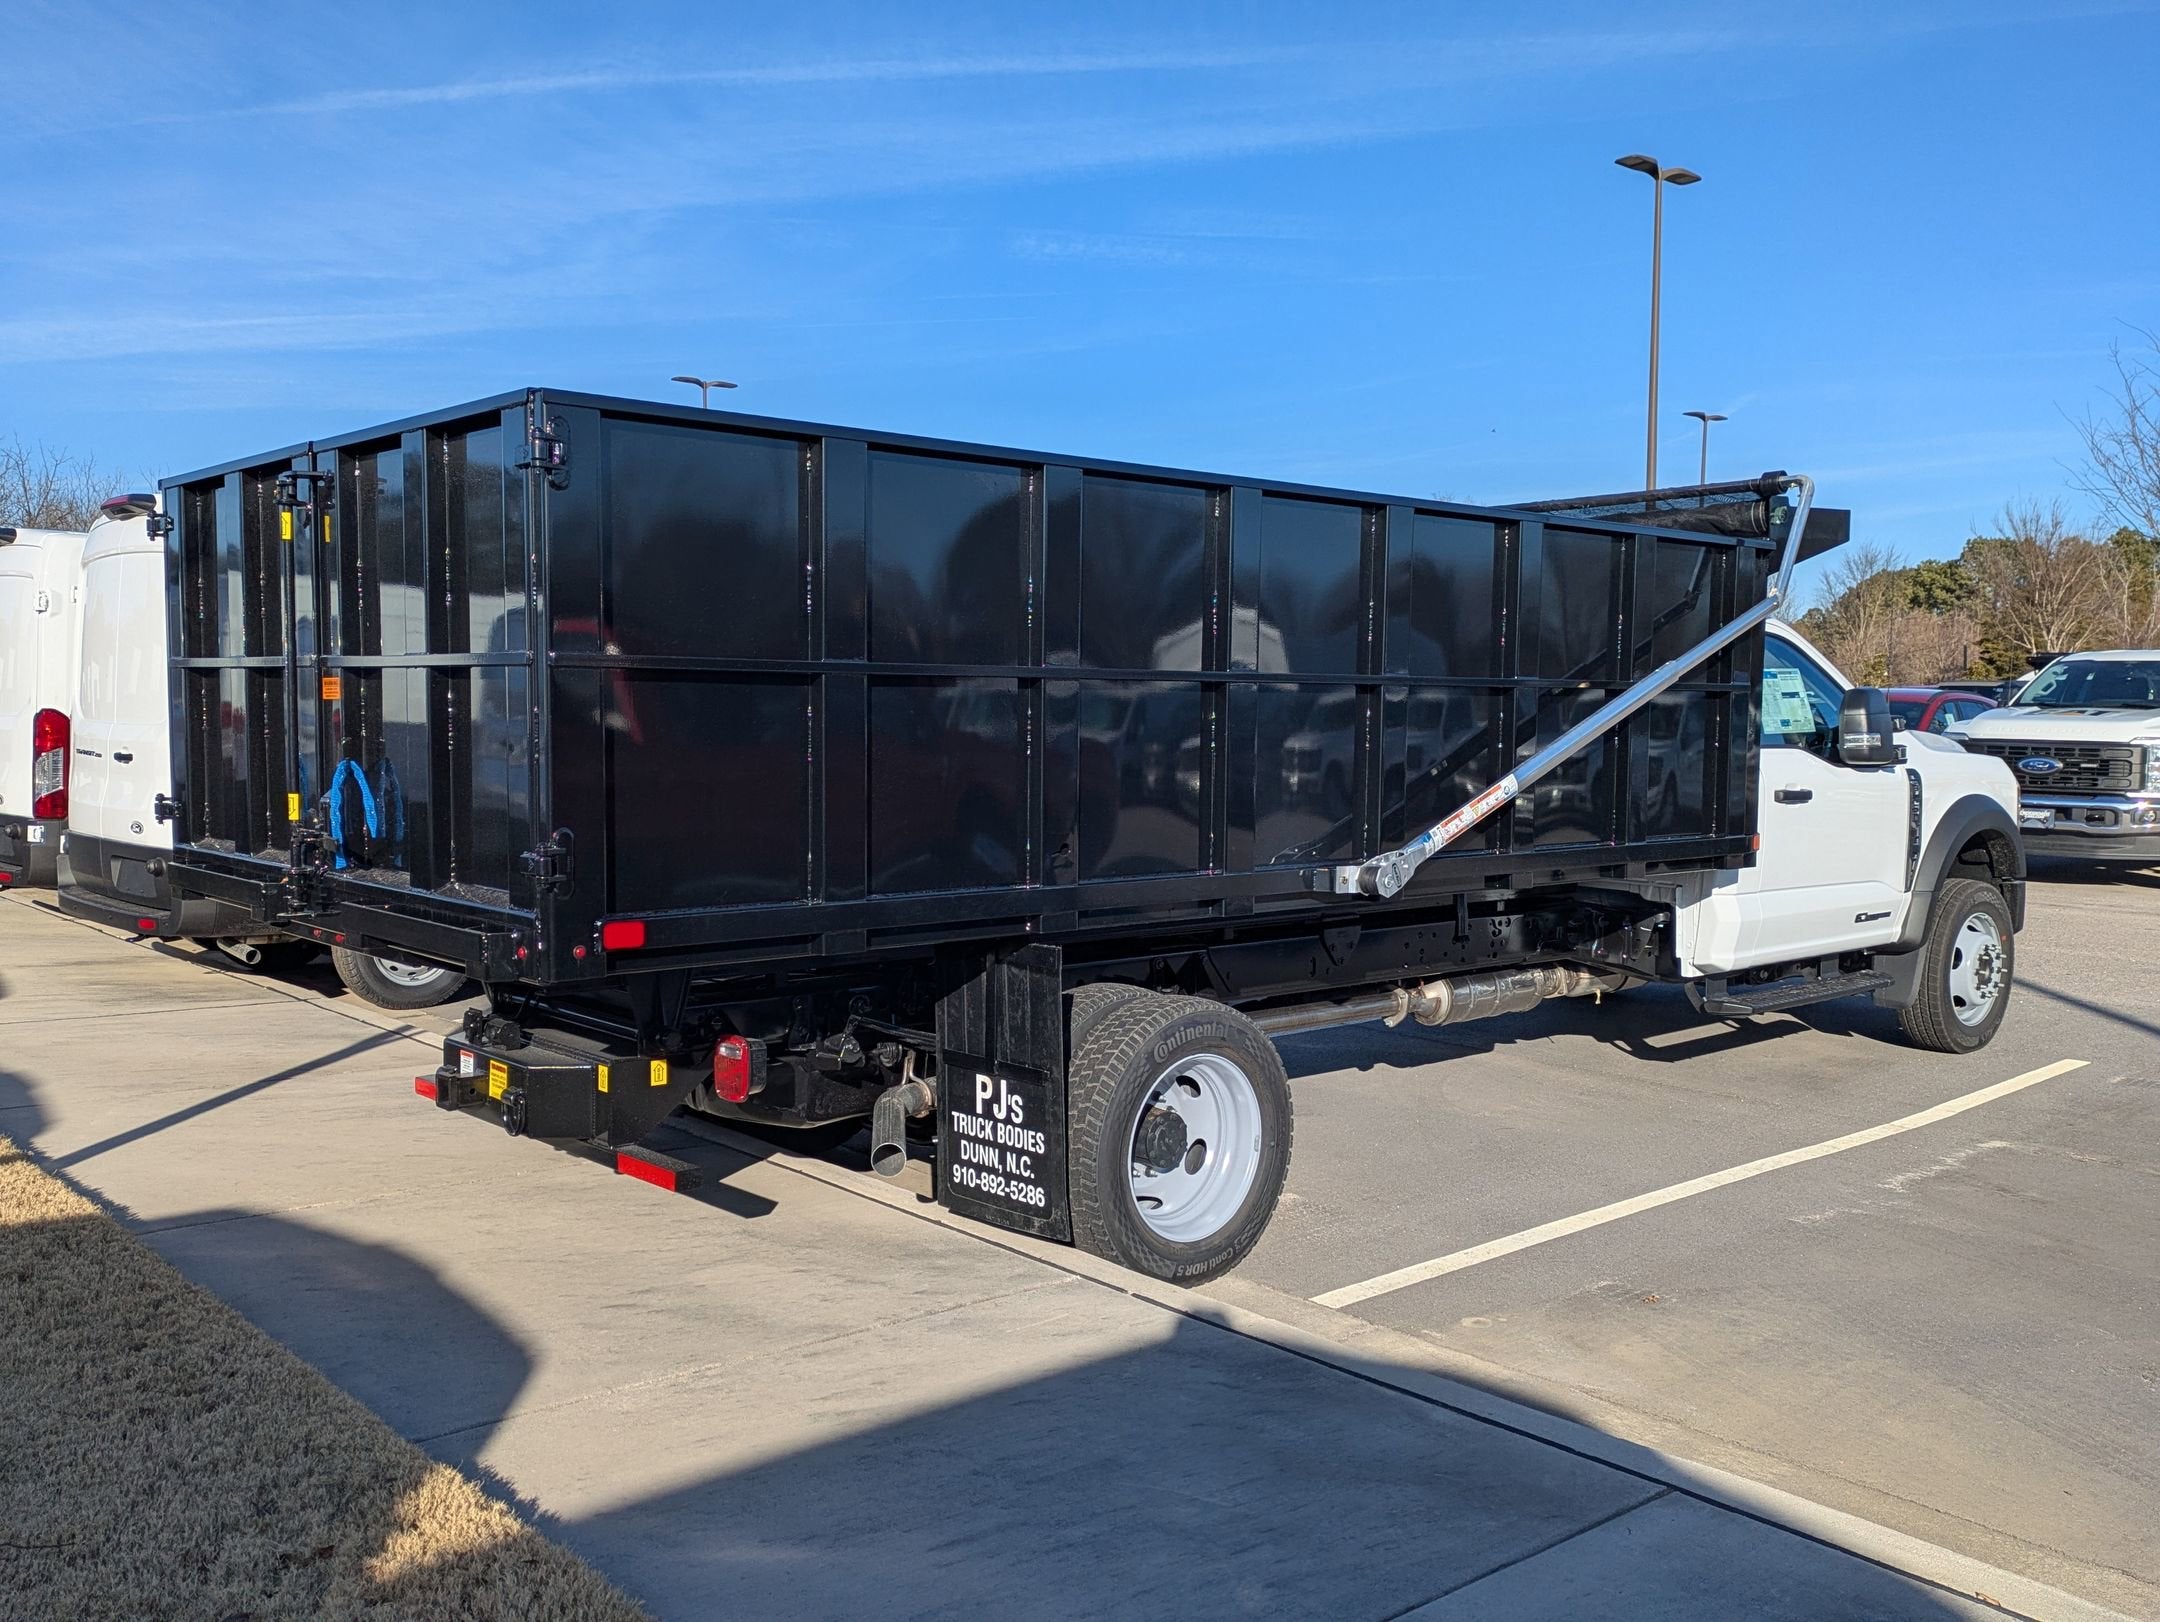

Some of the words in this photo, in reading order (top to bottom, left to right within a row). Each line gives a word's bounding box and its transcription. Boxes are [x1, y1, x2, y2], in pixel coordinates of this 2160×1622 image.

[1154, 1021, 1229, 1063] Continental
[951, 1110, 994, 1141] TRUCK
[997, 1122, 1045, 1154] BODIES
[960, 1139, 1003, 1174] DUNN,
[1006, 1151, 1035, 1179] N.C.
[952, 1163, 1046, 1208] 910-892-5286
